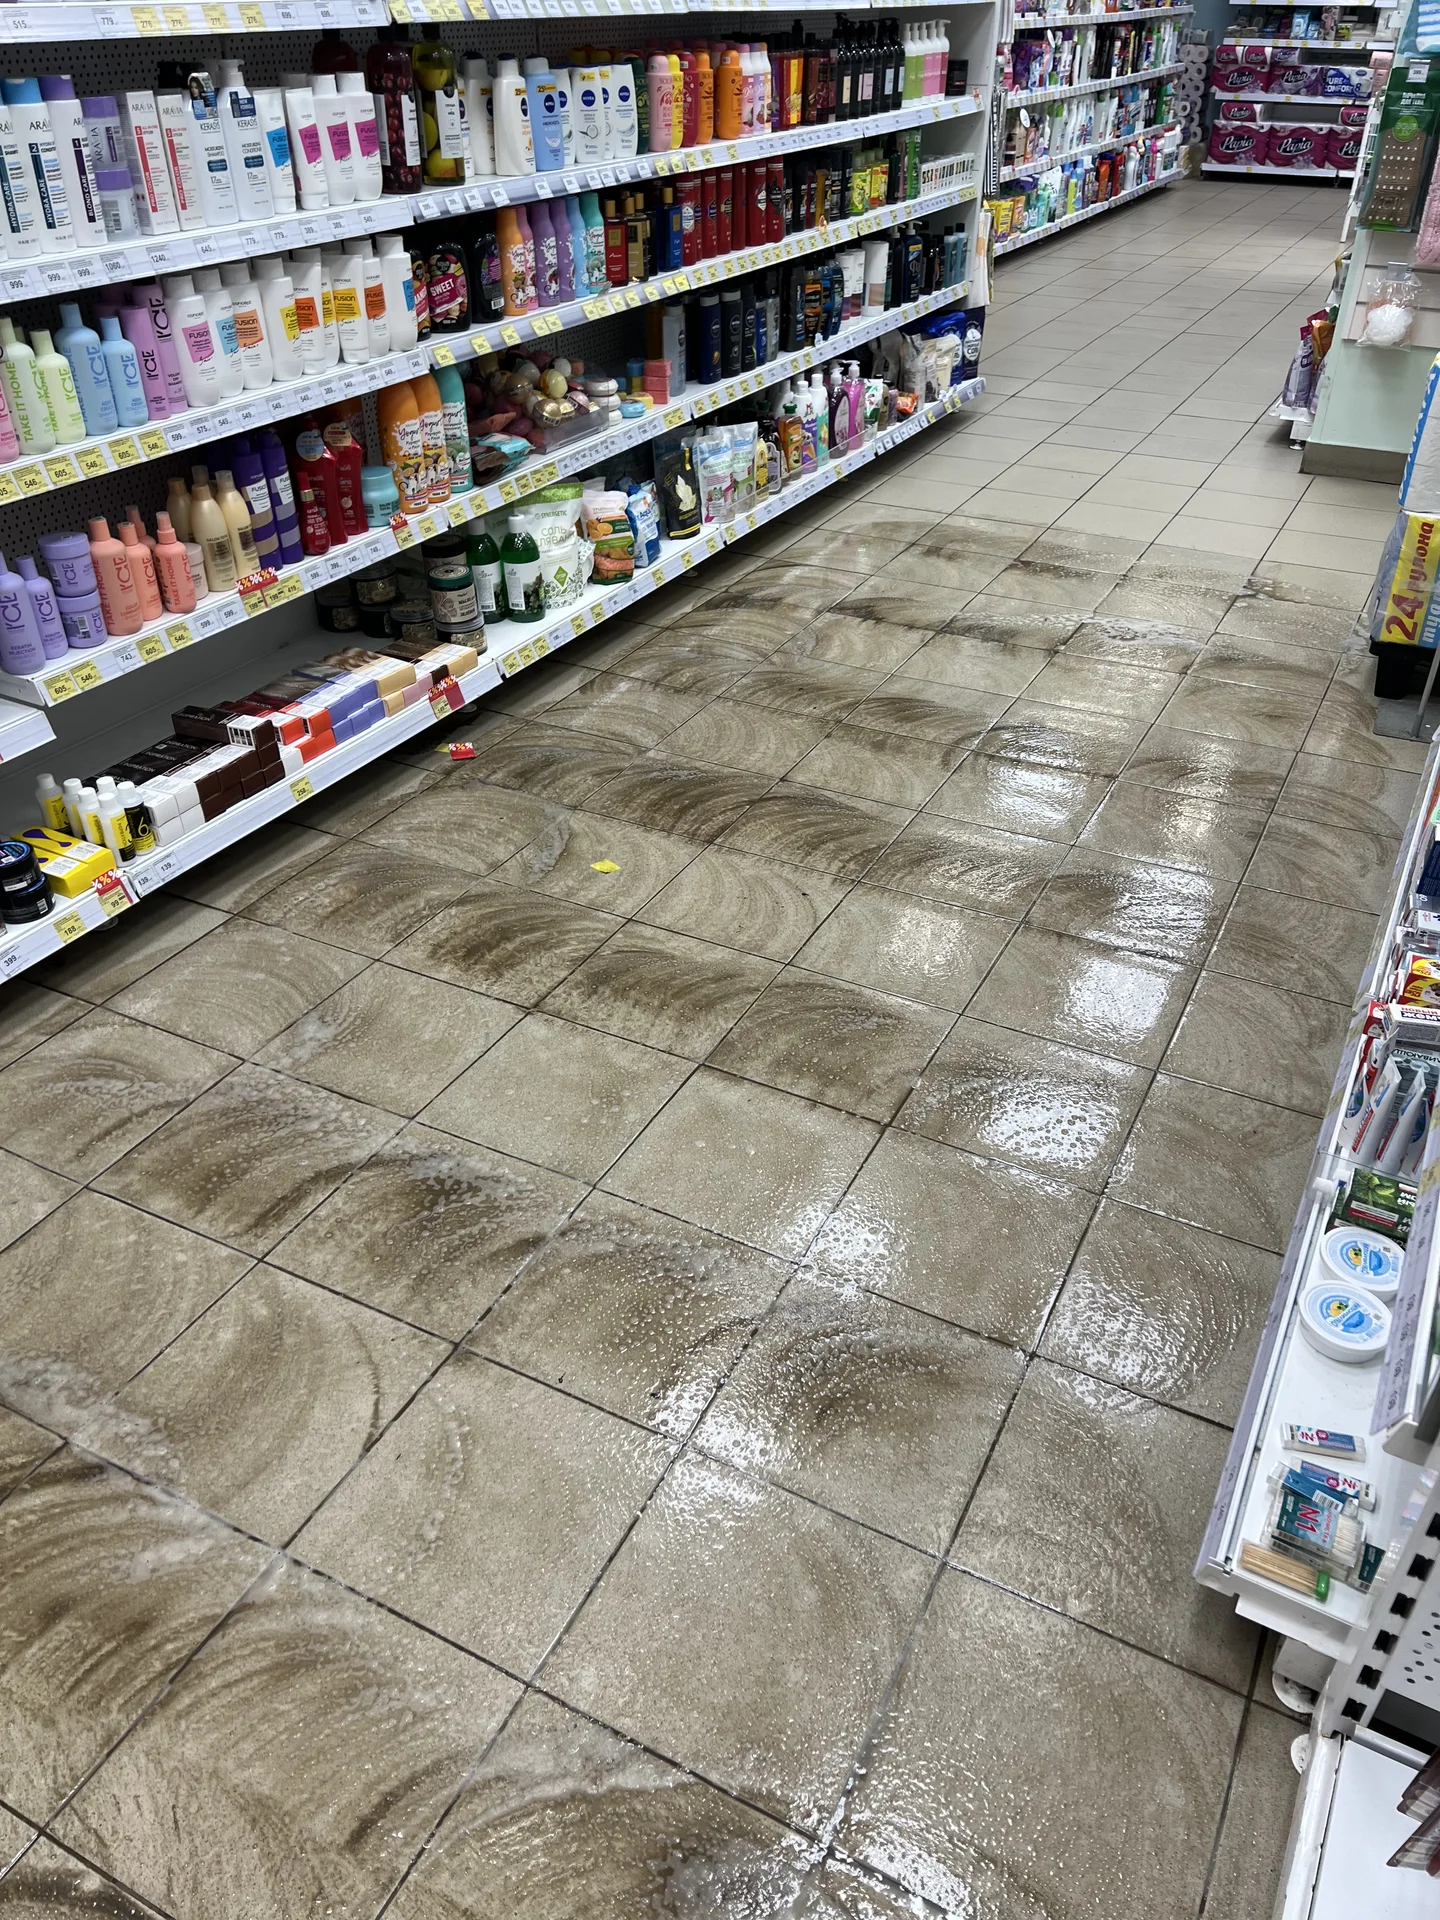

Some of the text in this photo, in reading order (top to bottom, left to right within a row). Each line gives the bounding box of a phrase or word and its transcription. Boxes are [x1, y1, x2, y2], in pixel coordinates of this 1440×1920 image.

[13, 21, 27, 29] 515
[101, 17, 114, 25] 779
[1249, 53, 1264, 61] Papia
[1226, 72, 1254, 85] Papia
[1282, 71, 1308, 83] Papia
[1354, 82, 1362, 92] 8
[1229, 109, 1250, 117] Papia
[237, 119, 257, 128] KERASYS
[1221, 138, 1254, 151] Papia
[1278, 139, 1313, 153] Papia
[1341, 142, 1360, 157] Pap
[173, 166, 183, 189] COLOR
[145, 172, 155, 195] COLOR
[38, 179, 53, 223] HYDRA CARE
[81, 175, 94, 217] BLOND CARE
[3, 182, 17, 227] HYDRA CARE
[151, 254, 166, 263] 1240
[105, 261, 121, 272] 1060
[47, 273, 61, 282] 999
[77, 268, 90, 277] 999
[9, 280, 23, 289] 999
[430, 279, 454, 296] SWEET
[39, 371, 50, 398] HOME
[6, 362, 33, 443] TAKE IT HOME
[50, 411, 59, 432] TAKE
[197, 426, 209, 434] 575
[171, 433, 182, 441] 599
[148, 442, 159, 451] 546
[118, 451, 130, 460] 605
[86, 461, 98, 469] 546
[54, 468, 67, 478] 605
[24, 478, 37, 488] 546
[541, 510, 567, 519] SYNERGETIC
[541, 526, 567, 536] СОЛЬ
[166, 557, 175, 580] HOME
[1385, 522, 1434, 640] 24 рулона
[172, 590, 181, 607] TAKE
[103, 604, 115, 625] TAKE
[174, 634, 186, 643] 546
[9, 647, 36, 655] INJECTION
[145, 646, 156, 655] 605
[121, 654, 133, 662] 743
[81, 674, 93, 683] 546
[54, 685, 66, 695] 605
[145, 751, 177, 761] INSPIRATION
[123, 762, 156, 773] INSPIRATION
[138, 817, 149, 836] 6
[161, 862, 172, 872] 139
[137, 876, 149, 886] 139
[111, 899, 119, 908] 99
[64, 926, 77, 936] 188
[3, 955, 17, 967] 399
[1295, 1503, 1322, 1534] N1
[1322, 1510, 1332, 1544] УБОЧИСТКА
